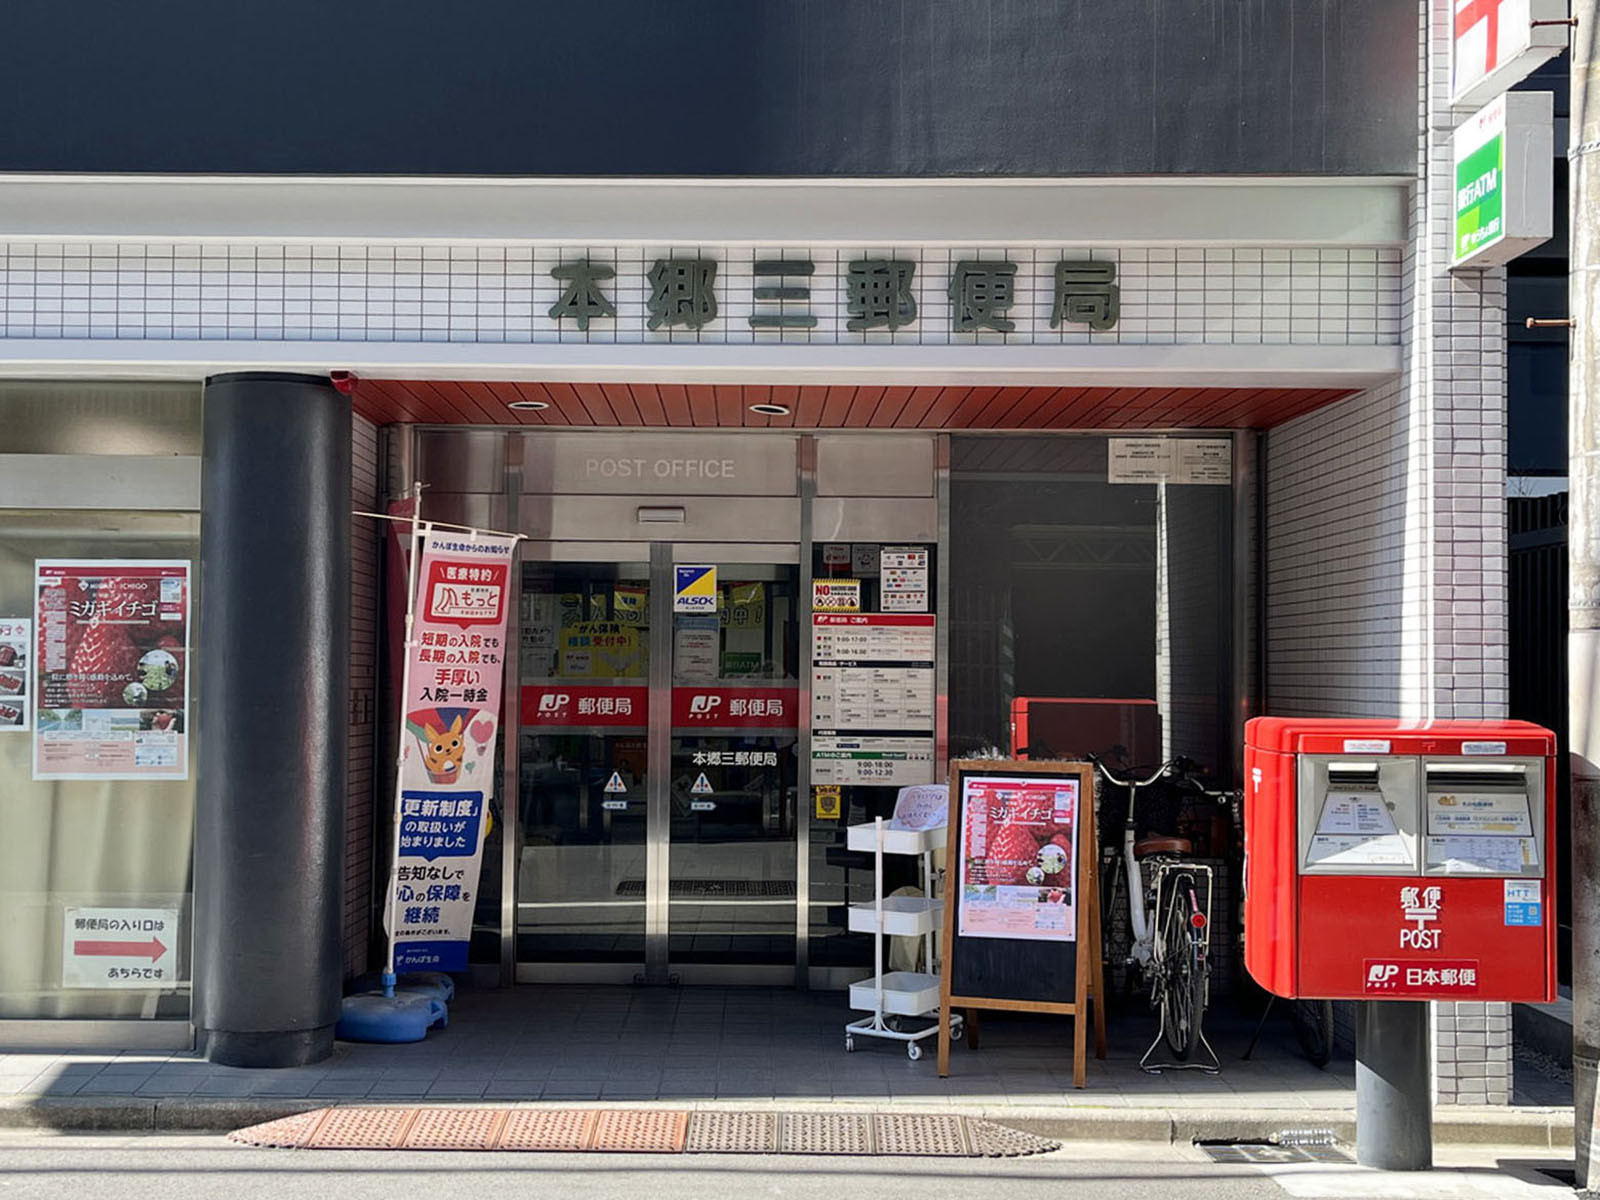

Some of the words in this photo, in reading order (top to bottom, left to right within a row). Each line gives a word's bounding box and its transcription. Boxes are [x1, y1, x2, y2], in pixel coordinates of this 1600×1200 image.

[548, 257, 1121, 332] 本郷三郵便局
[586, 459, 646, 479] POST
[654, 459, 735, 479] OFFICE
[446, 566, 492, 582] 医療特約
[815, 585, 830, 596] NO
[461, 591, 497, 607] もっと
[677, 596, 714, 606] ALSOK
[70, 600, 158, 617] ミガキイチゴ
[420, 632, 499, 648] 短期の入院でも
[435, 668, 480, 686] 手厚い
[420, 687, 488, 702] 入院一時金
[577, 698, 632, 716] 郵便局
[729, 699, 784, 717] 郵便局
[692, 751, 778, 767] 本郷三郵便局
[401, 798, 479, 817] 更新制度」
[989, 806, 1053, 821] ミガキイチゴ
[404, 820, 466, 833] の取扱いが
[400, 835, 466, 848] 始まりました
[398, 865, 464, 881] 告知なしで
[396, 884, 471, 902] 心の保障を
[1400, 886, 1442, 909] 郵便
[403, 906, 440, 924] 継続
[74, 918, 165, 931] 郵便局の入り口は
[1400, 929, 1442, 949] POST
[107, 968, 164, 979] あちらです
[1406, 967, 1477, 987] 日本郵便
